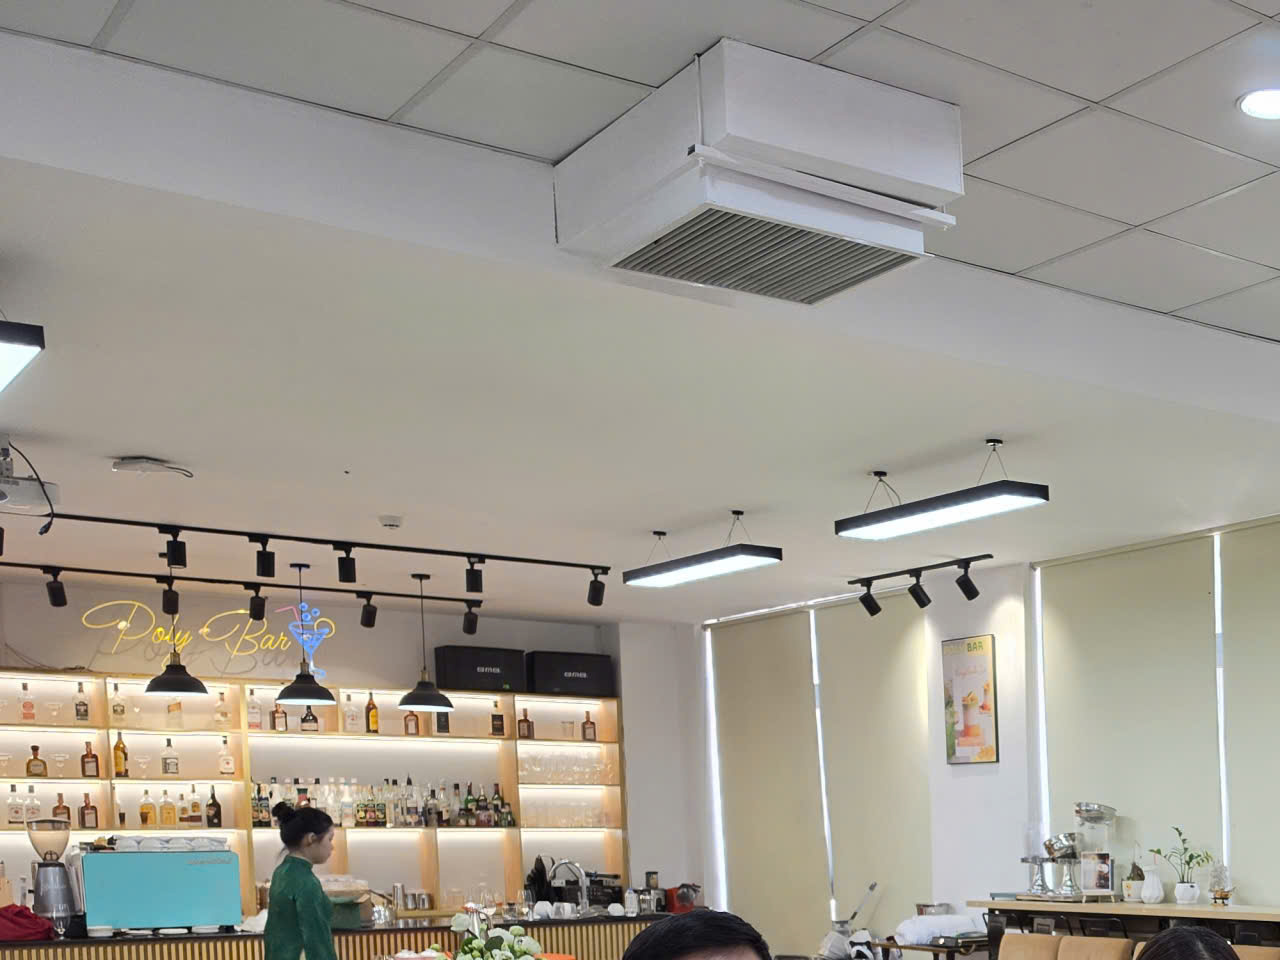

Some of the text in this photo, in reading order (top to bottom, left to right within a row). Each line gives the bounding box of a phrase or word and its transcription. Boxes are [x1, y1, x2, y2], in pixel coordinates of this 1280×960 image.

[82, 600, 291, 669] Poly Bar
[967, 641, 983, 652] BAR
